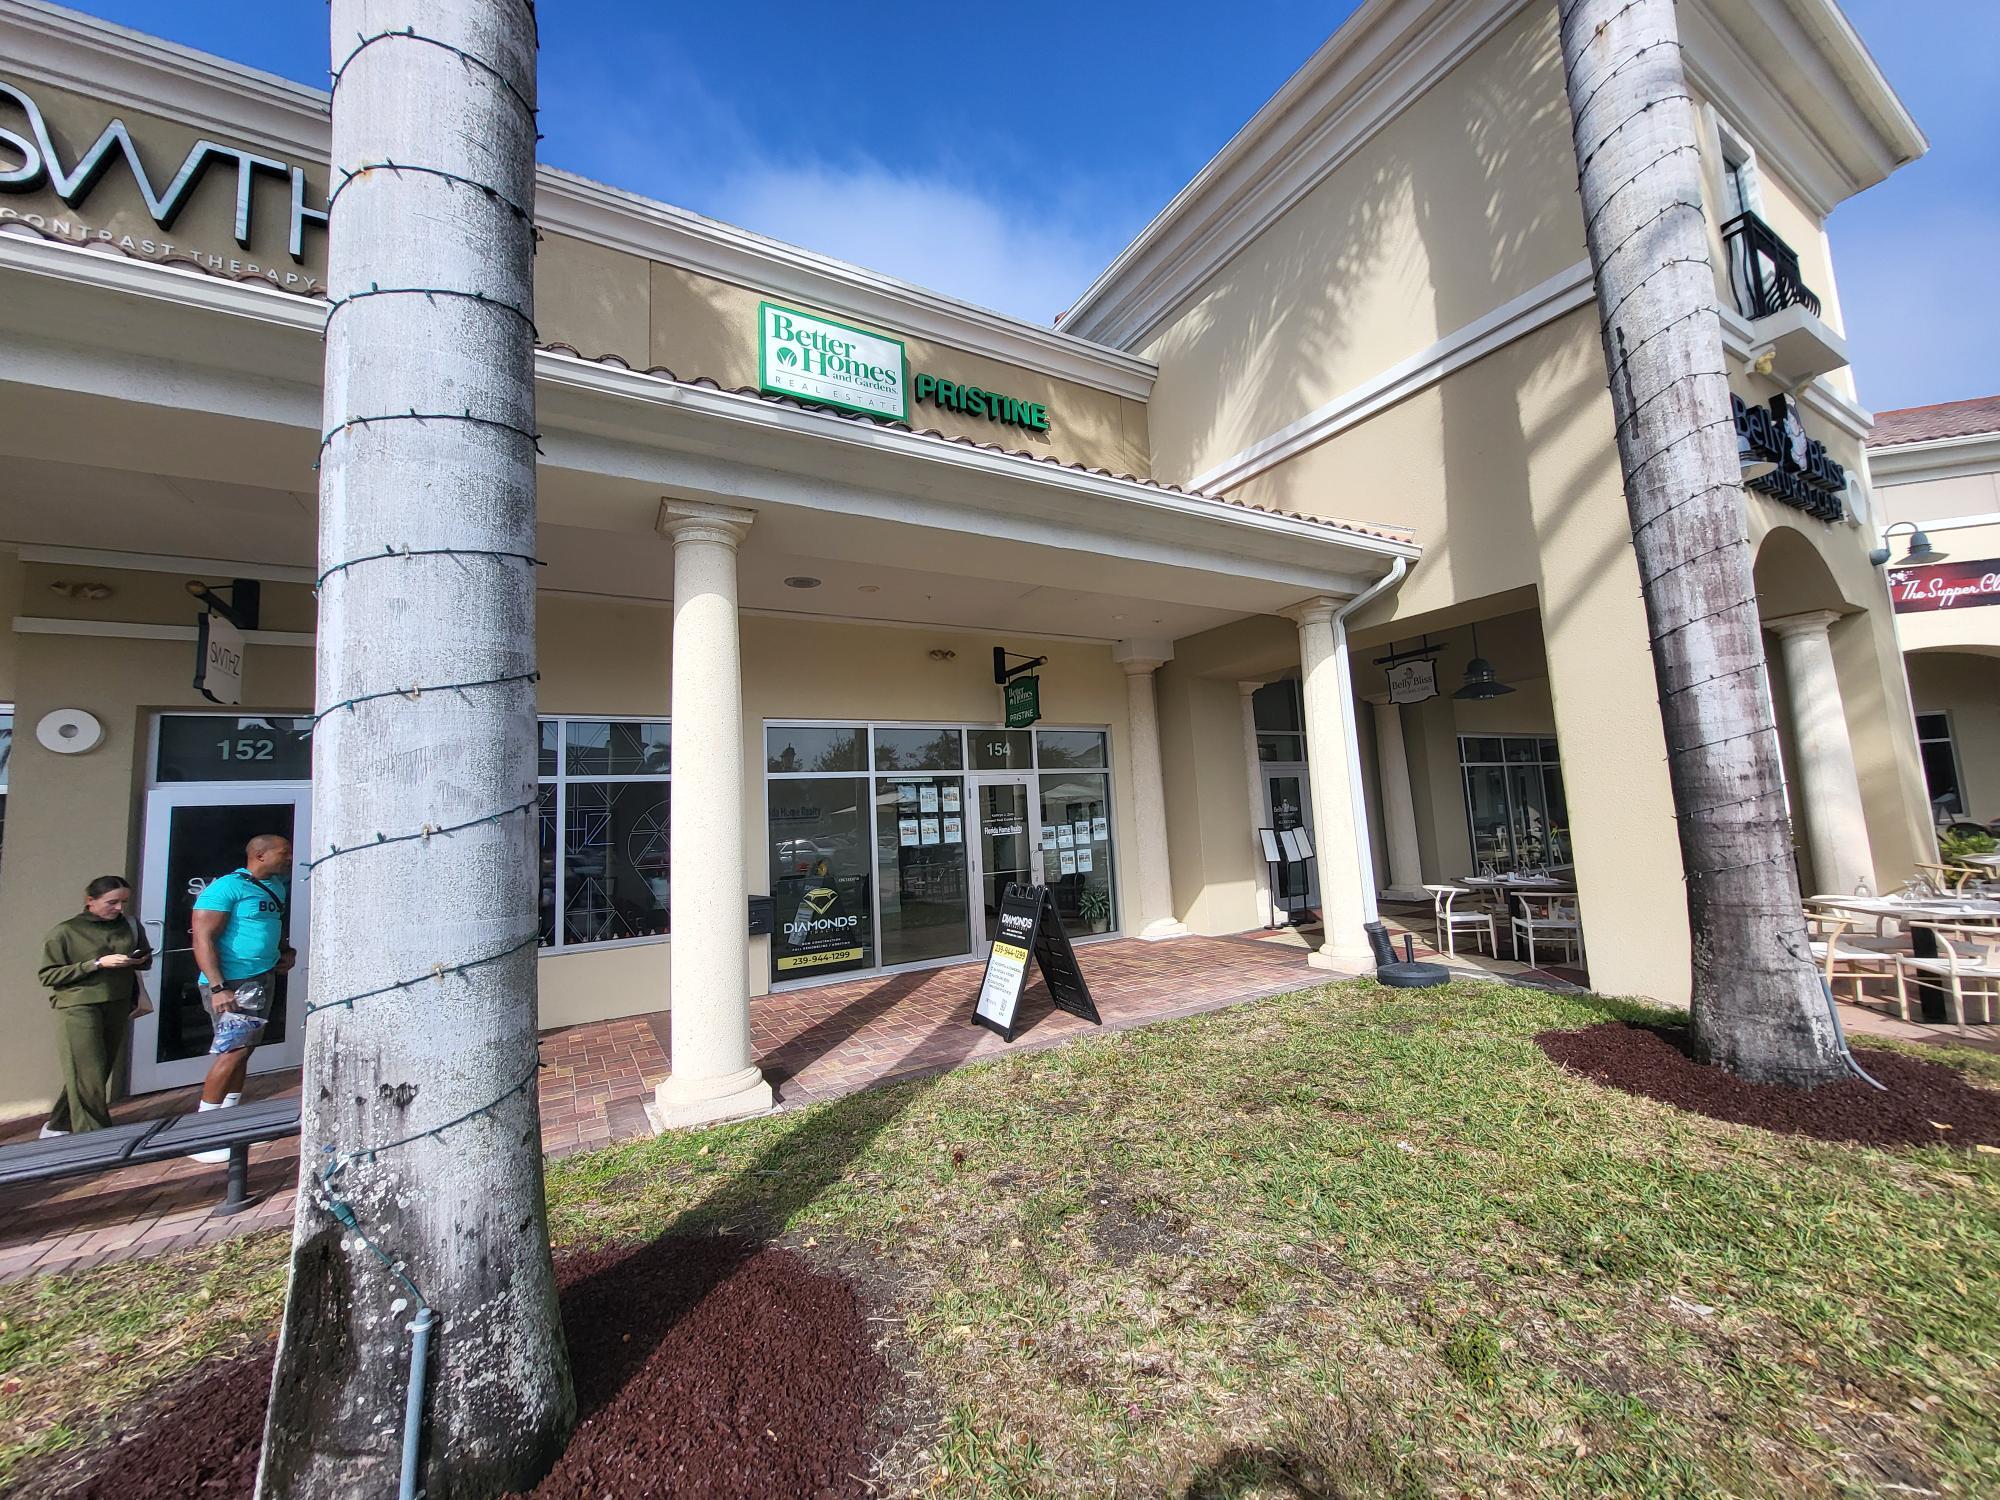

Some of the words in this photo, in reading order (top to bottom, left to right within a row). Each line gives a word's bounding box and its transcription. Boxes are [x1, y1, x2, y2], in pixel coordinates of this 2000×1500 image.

[771, 313, 857, 359] Better
[801, 346, 897, 386] Homes
[832, 373, 852, 383] and
[775, 376, 822, 394] REAL
[833, 390, 898, 412] ESTATE
[915, 373, 1049, 431] PRISTINE
[1731, 392, 1786, 465] Belly
[1807, 438, 1848, 490] Bliss
[1902, 579, 1927, 600] The
[1928, 577, 1980, 607] Supper
[210, 641, 240, 676] SWTHZ
[1392, 679, 1411, 690] Belly
[1413, 676, 1433, 687] Bliss
[1010, 709, 1033, 721] PRISTINE
[216, 739, 274, 760] 152
[987, 742, 1011, 756] 154
[984, 826, 998, 835] Florida
[1011, 824, 1022, 834] Realty
[783, 915, 858, 934] DIAMONDS
[1001, 913, 1033, 929] DIAMONDS
[792, 951, 851, 966] 239-944-1299
[994, 944, 1027, 960] 239-944-1299
